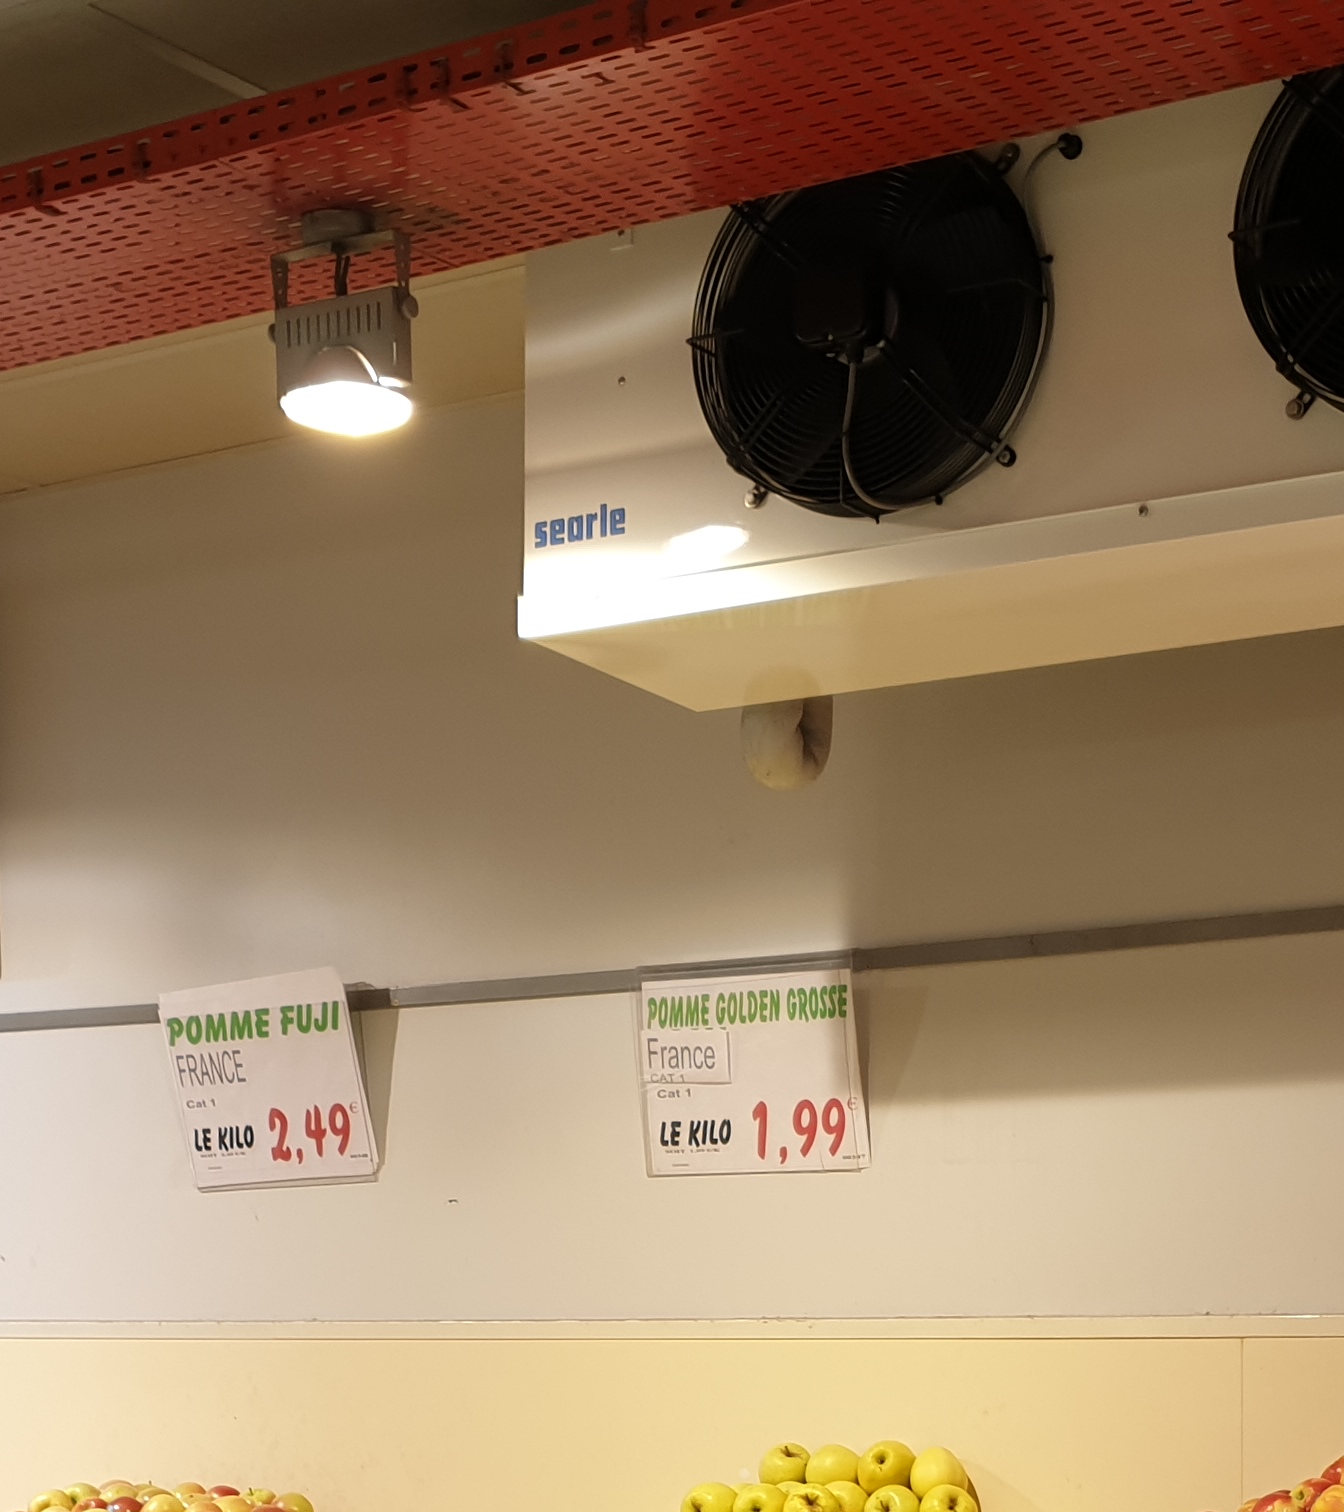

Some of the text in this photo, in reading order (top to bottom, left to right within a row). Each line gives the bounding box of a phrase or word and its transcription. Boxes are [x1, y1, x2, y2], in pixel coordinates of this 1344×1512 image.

[534, 503, 625, 548] searle
[647, 984, 848, 1030] POMME GOLDEN GROSSE
[166, 1000, 340, 1046] POMME FUJI
[175, 1050, 247, 1088] FRANCE
[647, 1038, 716, 1069] France
[186, 1100, 208, 1109] Cat
[657, 1088, 691, 1099] Cat 1
[194, 1125, 254, 1152] LE KILO
[659, 1119, 732, 1148] LE KILO
